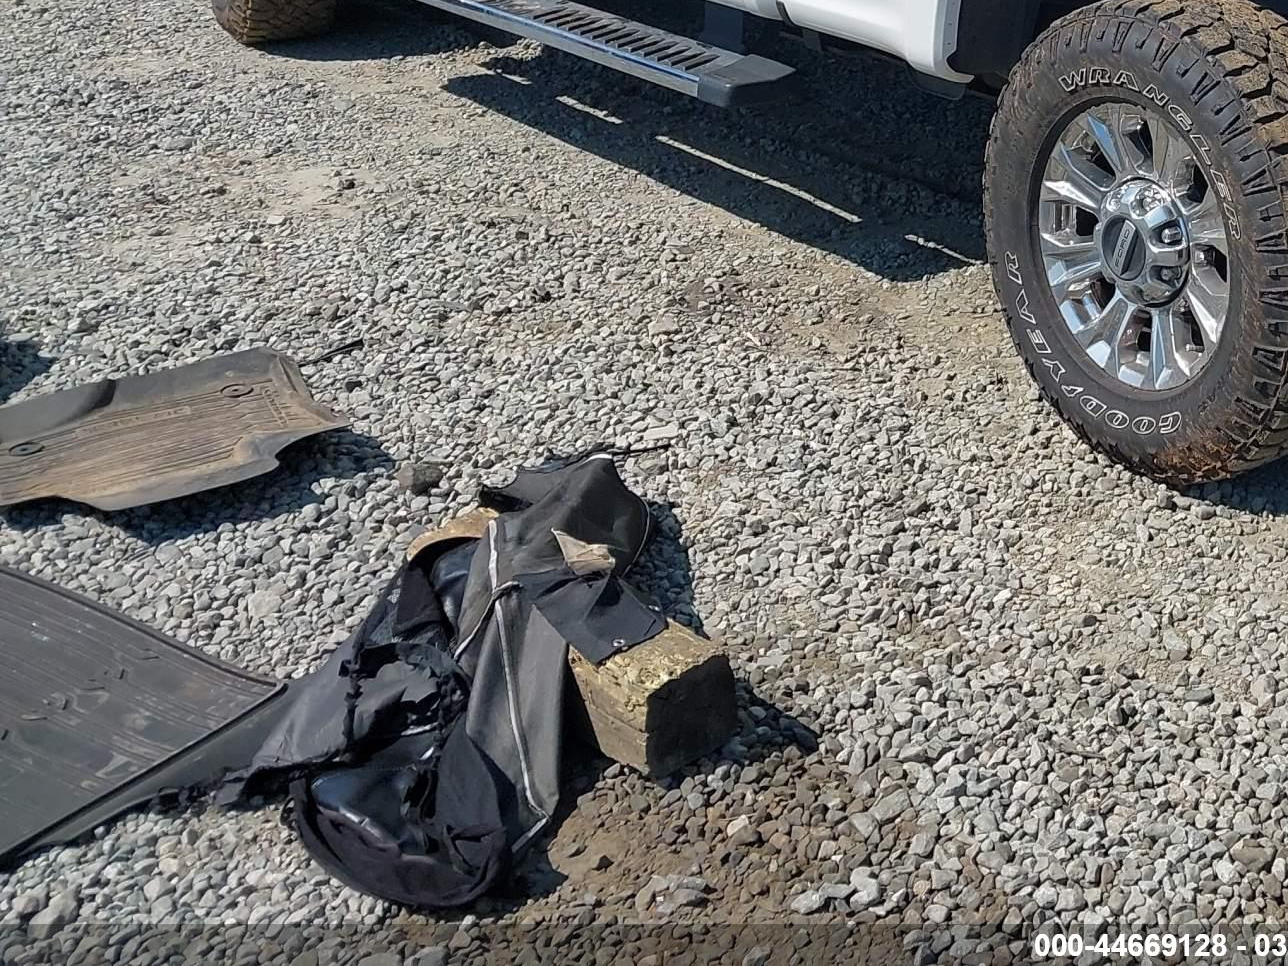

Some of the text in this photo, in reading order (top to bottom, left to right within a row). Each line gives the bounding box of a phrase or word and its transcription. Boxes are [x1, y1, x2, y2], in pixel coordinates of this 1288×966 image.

[1058, 66, 1241, 240] WRANGLER
[1114, 229, 1130, 268] FORD
[1004, 251, 1182, 434] GOODYEAR
